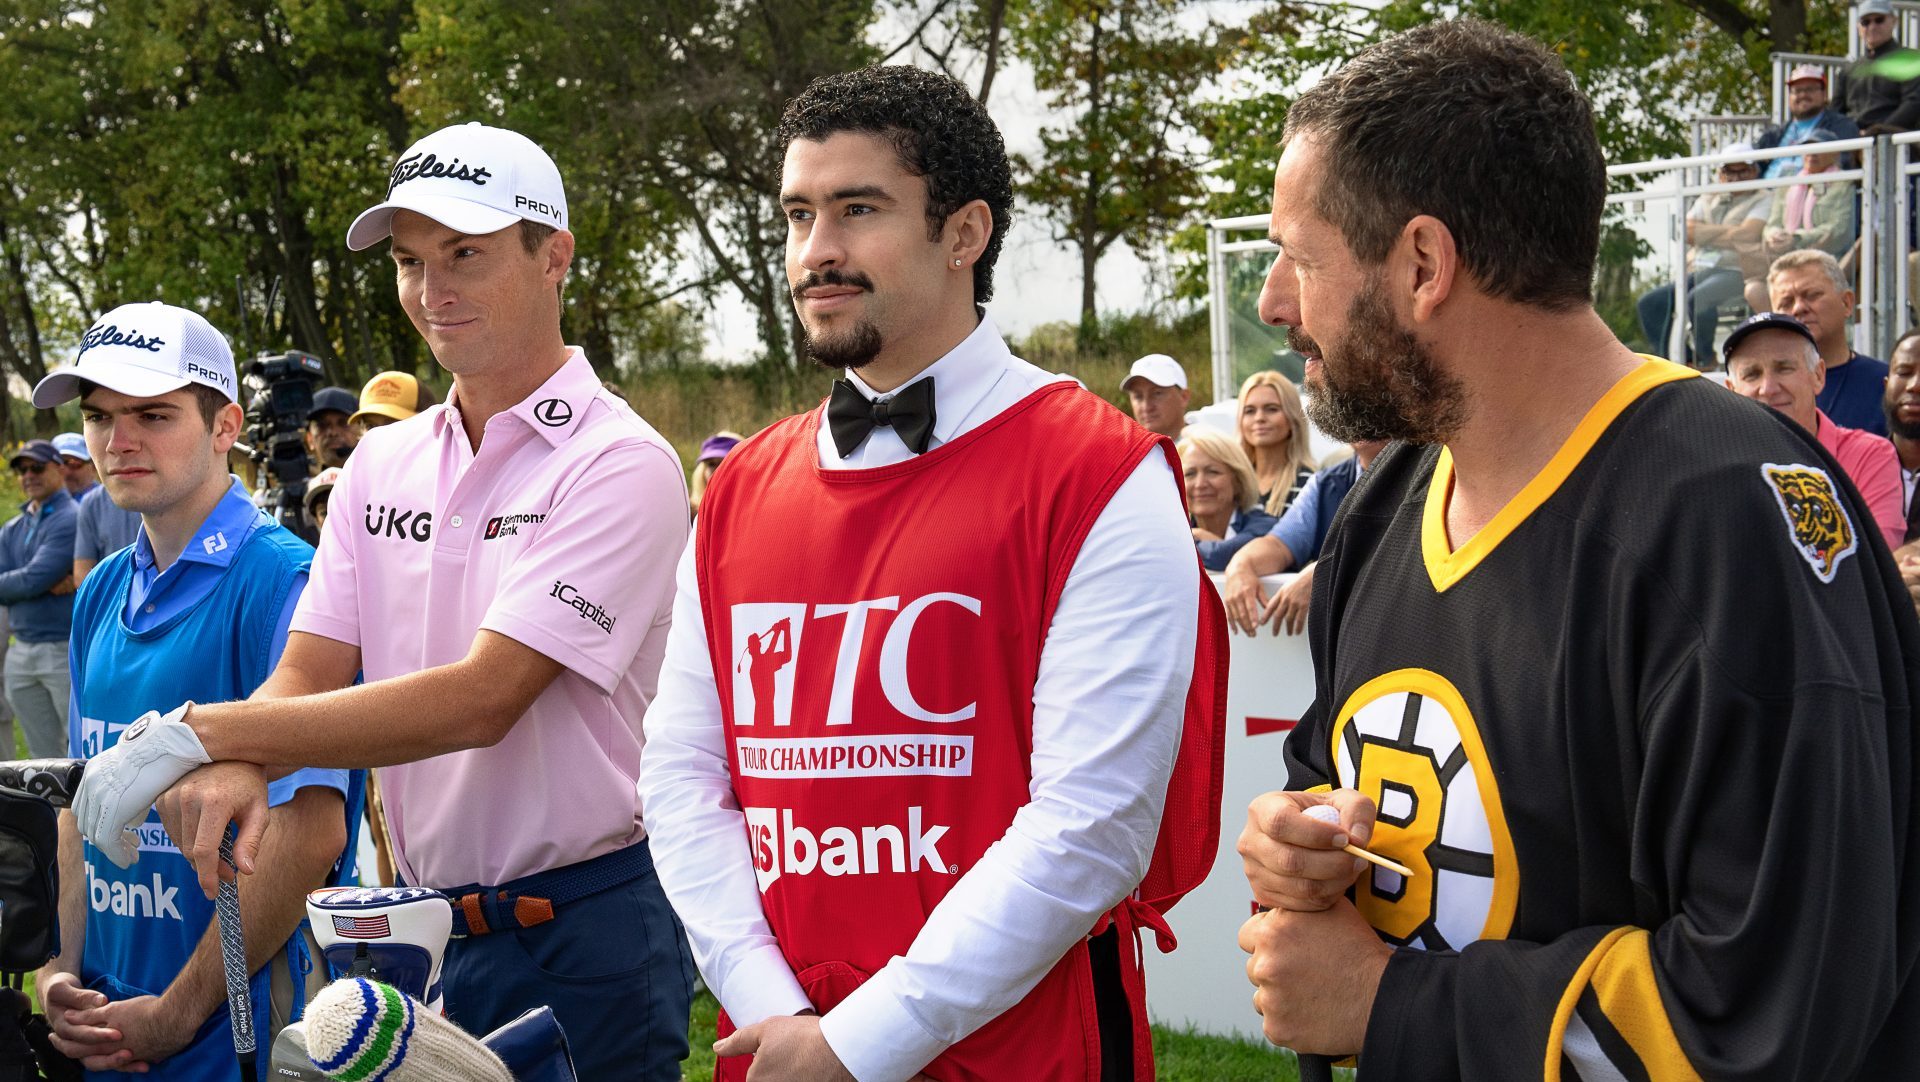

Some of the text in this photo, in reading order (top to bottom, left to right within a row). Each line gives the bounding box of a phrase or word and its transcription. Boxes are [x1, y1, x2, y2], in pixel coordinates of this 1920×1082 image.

[385, 152, 492, 202] Titleist
[515, 194, 549, 215] PRO
[75, 324, 166, 367] Titleist
[188, 362, 218, 381] PRO
[549, 580, 617, 635] iCapital
[813, 591, 982, 727] TC
[740, 743, 967, 771] TOUR CHAMPIONSHIP
